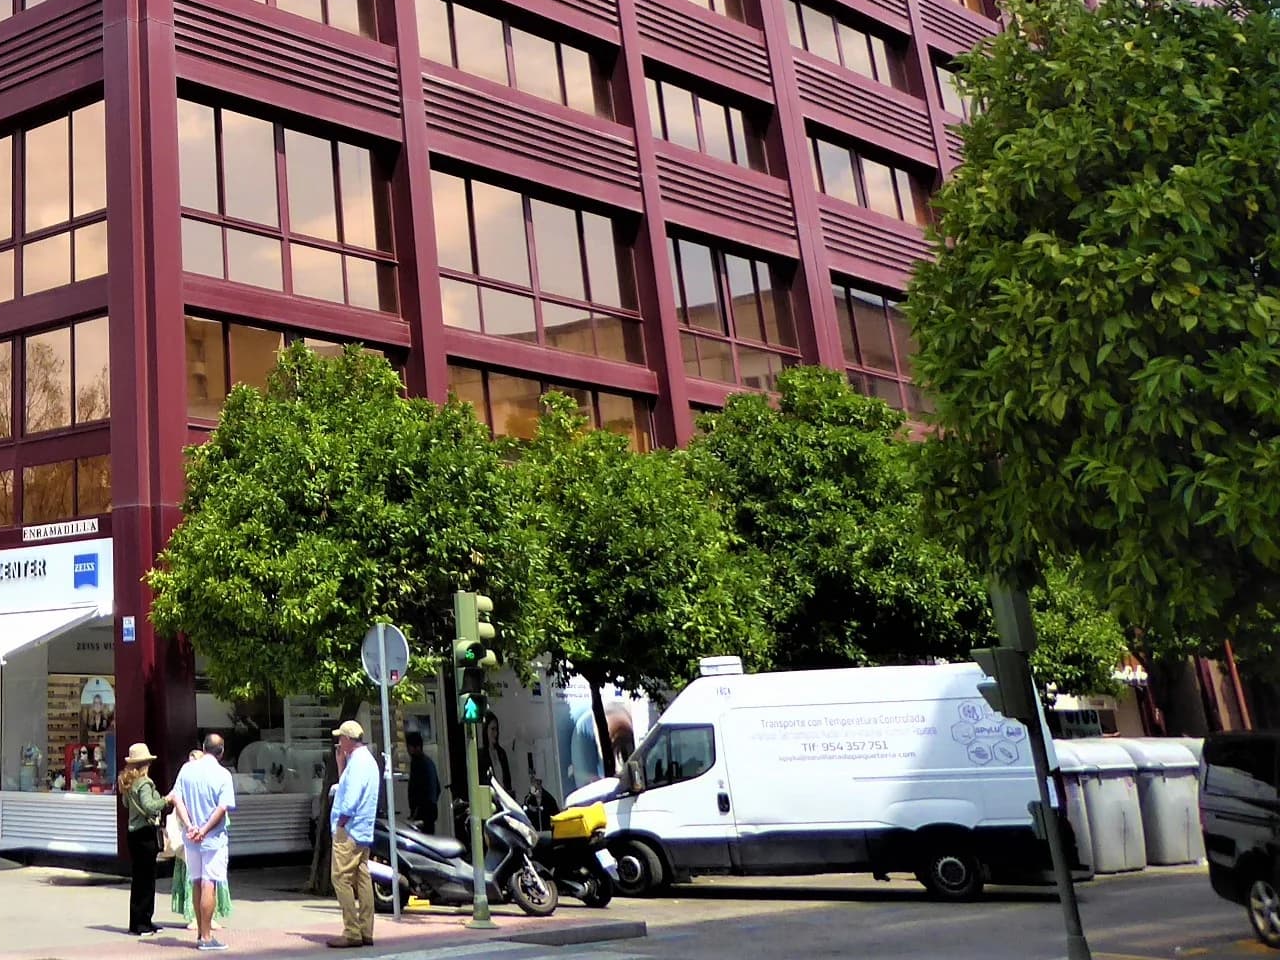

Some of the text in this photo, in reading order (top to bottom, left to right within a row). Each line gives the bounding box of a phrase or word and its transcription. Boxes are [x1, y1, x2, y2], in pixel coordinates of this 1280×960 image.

[23, 520, 98, 540] ENRAMADILLA
[74, 561, 96, 572] ZEISS
[760, 719, 806, 730] Transporte
[821, 742, 844, 752] 954
[846, 741, 866, 751] 357
[868, 740, 889, 750] 751
